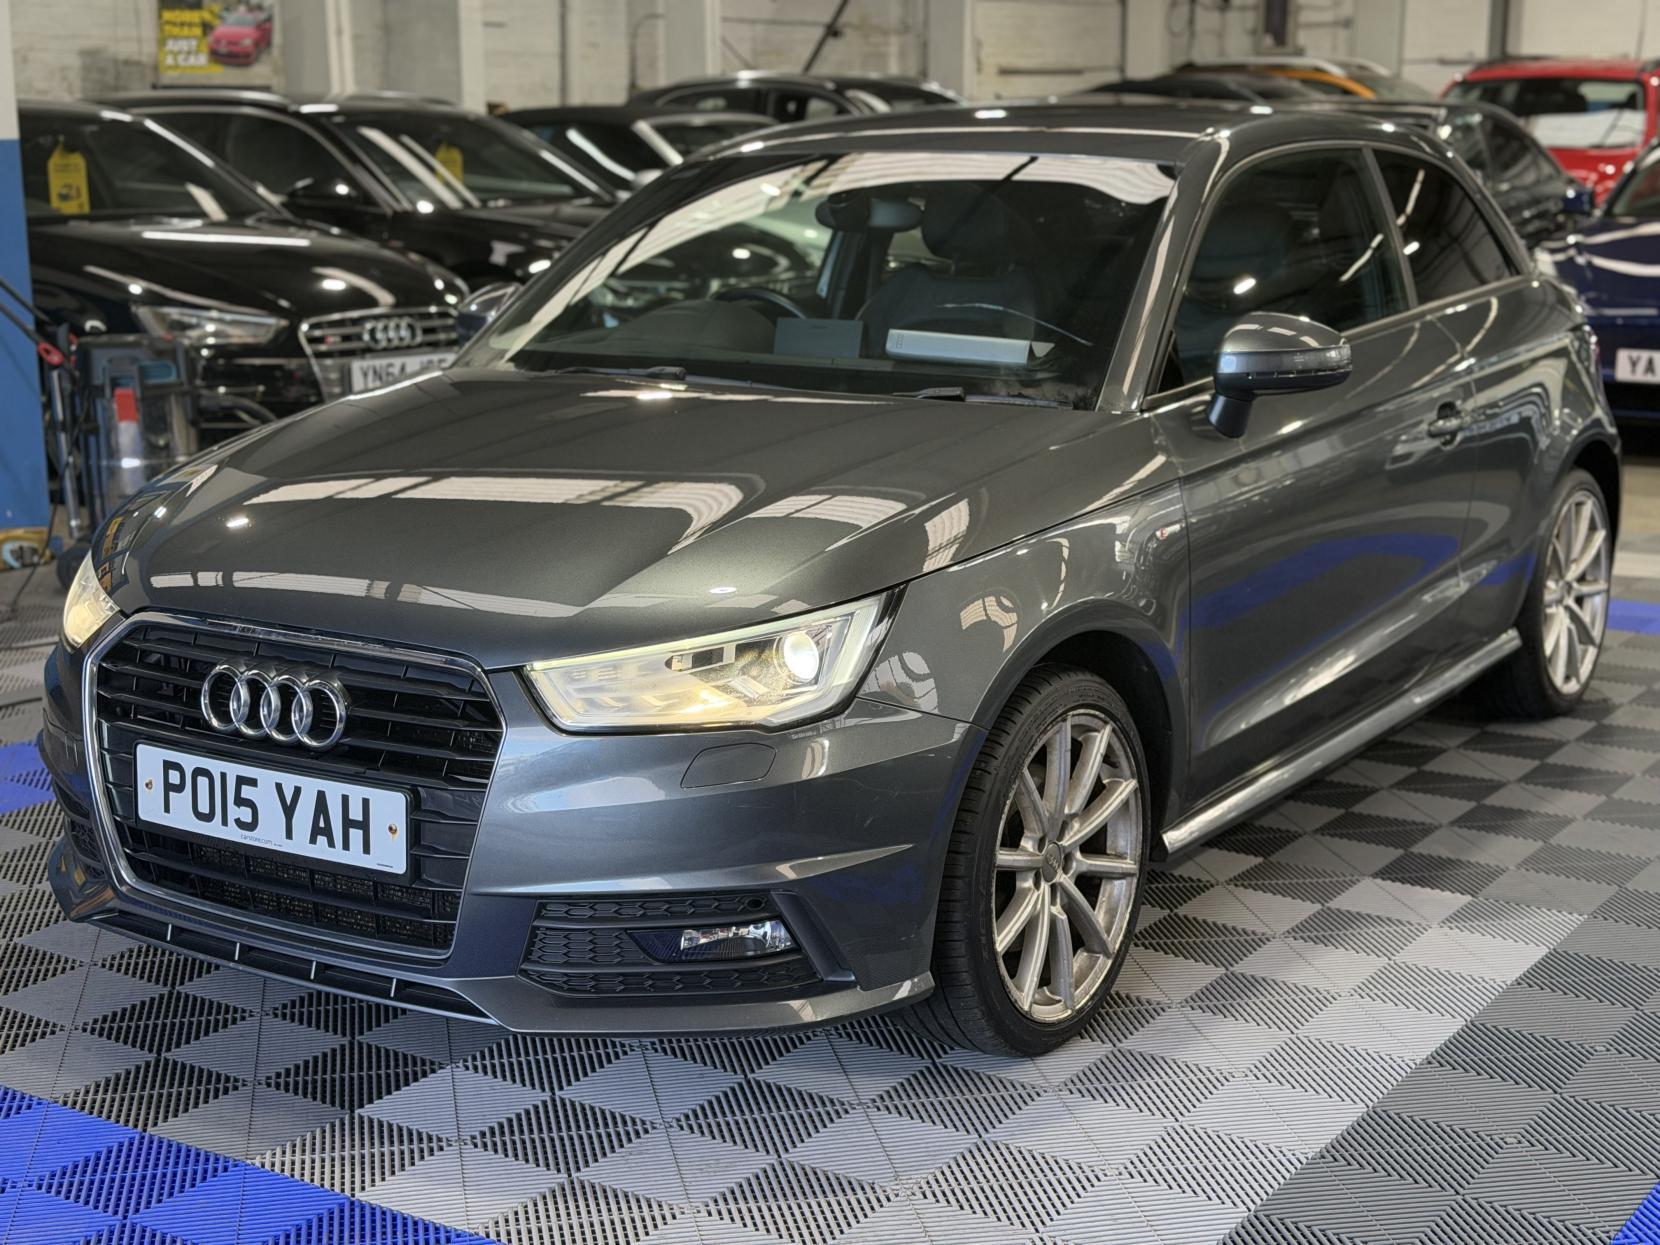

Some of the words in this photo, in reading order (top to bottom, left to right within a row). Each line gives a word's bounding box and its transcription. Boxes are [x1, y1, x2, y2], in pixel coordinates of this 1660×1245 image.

[165, 38, 198, 51] JUST
[164, 53, 176, 66] A
[177, 53, 208, 66] CAR
[162, 759, 259, 832] PO15
[275, 782, 371, 855] YAH
